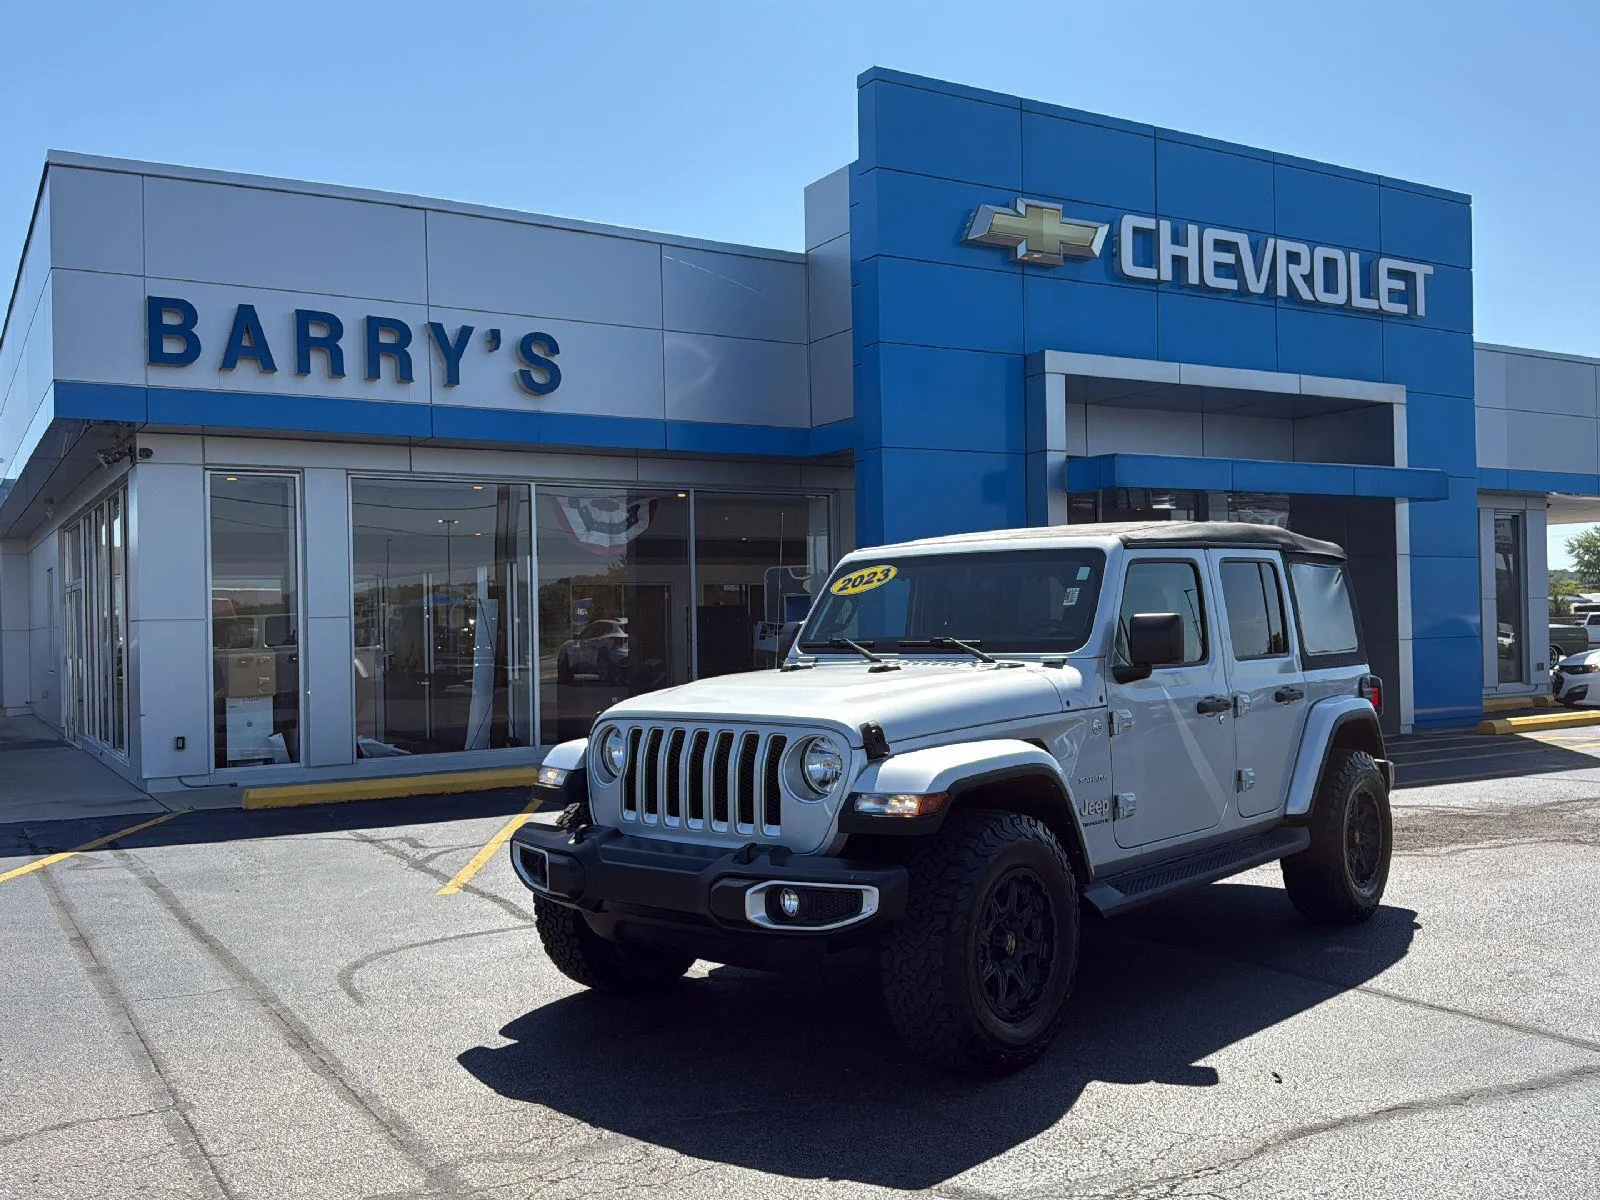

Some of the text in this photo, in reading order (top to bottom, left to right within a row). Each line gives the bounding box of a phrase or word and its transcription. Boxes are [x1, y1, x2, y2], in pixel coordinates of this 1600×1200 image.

[1115, 213, 1434, 317] CHEVROLET
[147, 295, 562, 396] BARRY'S
[836, 568, 892, 593] 2023
[1080, 798, 1109, 817] Jeep
